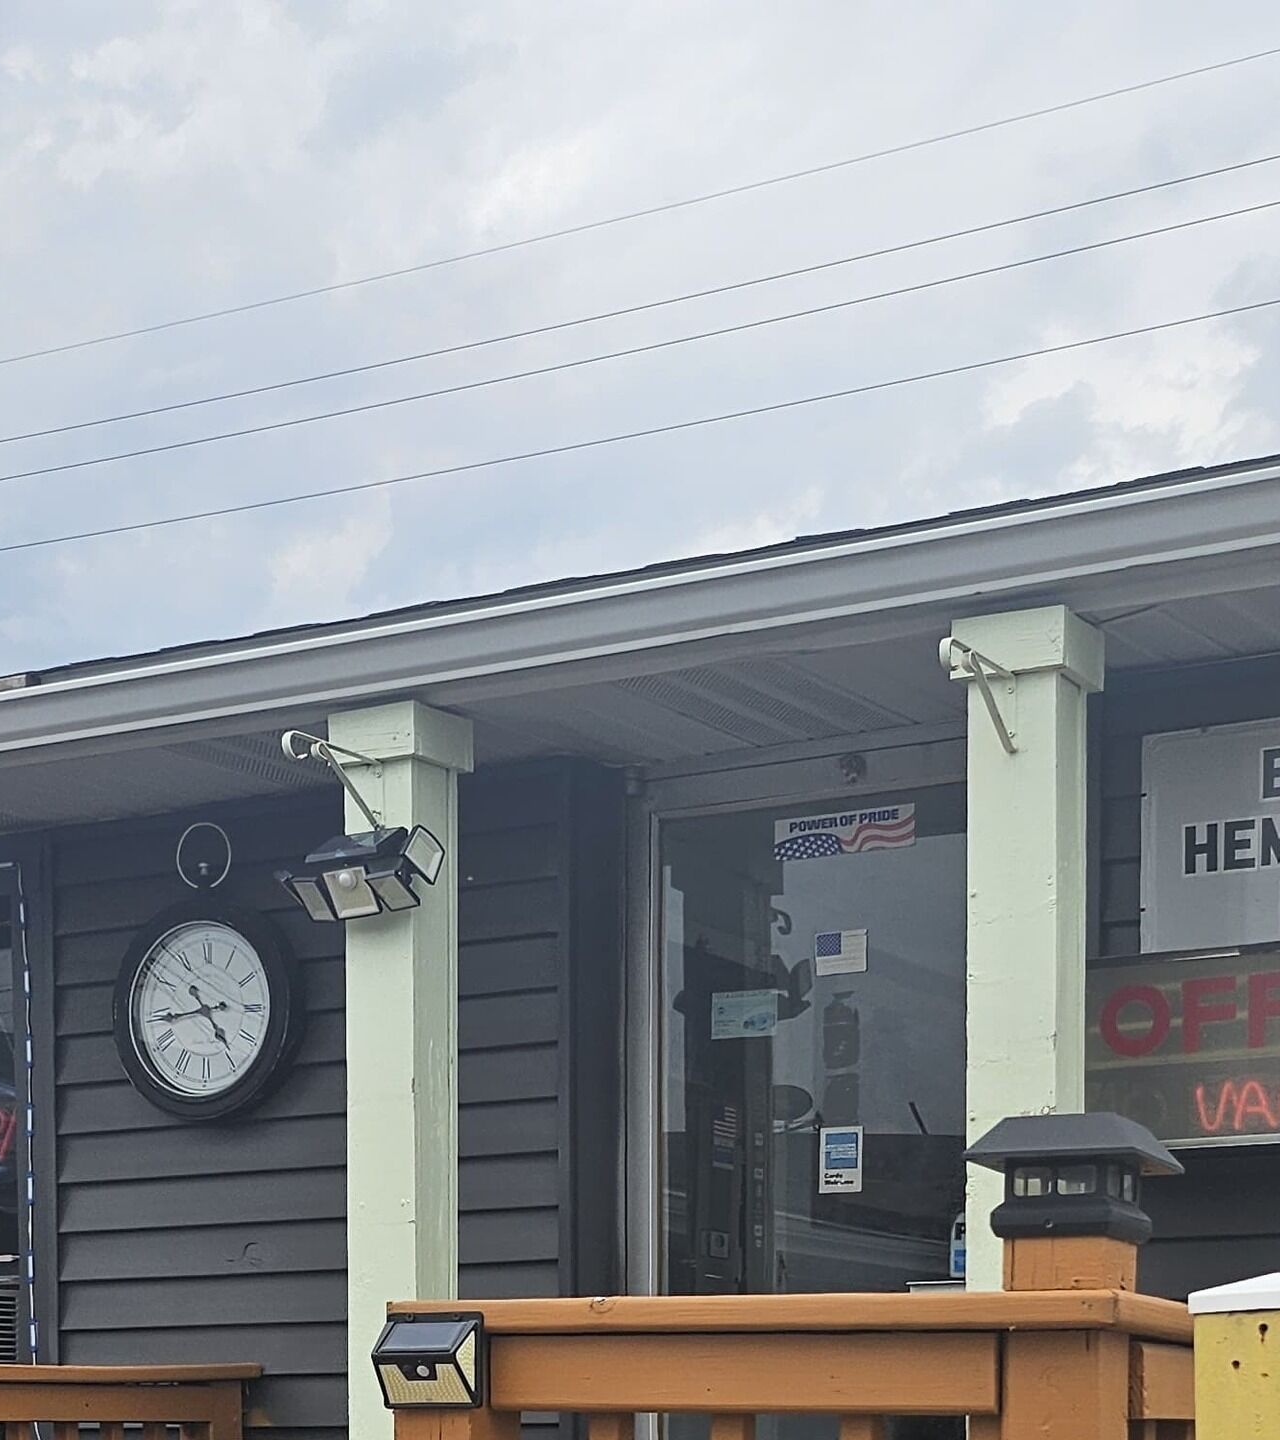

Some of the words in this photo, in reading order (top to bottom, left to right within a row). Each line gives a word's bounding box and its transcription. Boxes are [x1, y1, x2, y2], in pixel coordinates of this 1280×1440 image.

[789, 818, 838, 834] POWER
[839, 814, 857, 828] OF
[858, 808, 900, 825] PRIDE
